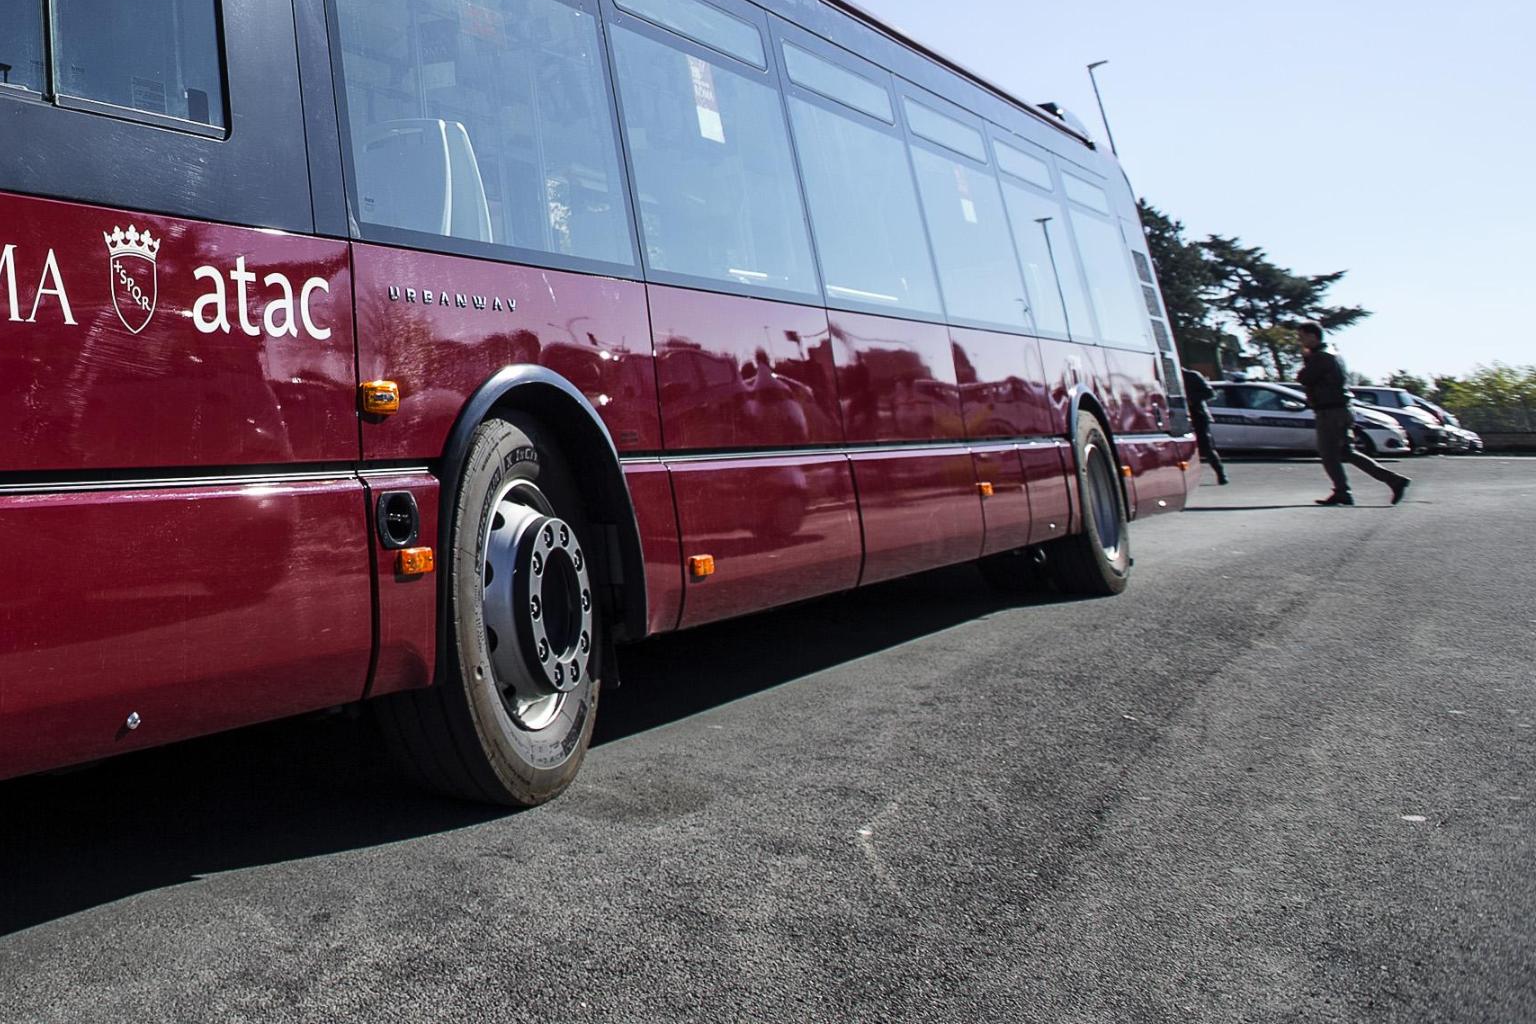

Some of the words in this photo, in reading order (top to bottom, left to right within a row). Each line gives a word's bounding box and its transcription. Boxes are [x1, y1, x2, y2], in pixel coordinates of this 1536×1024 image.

[120, 269, 151, 312] SPQR
[192, 255, 332, 340] atac
[388, 285, 516, 313] URBANWAY
